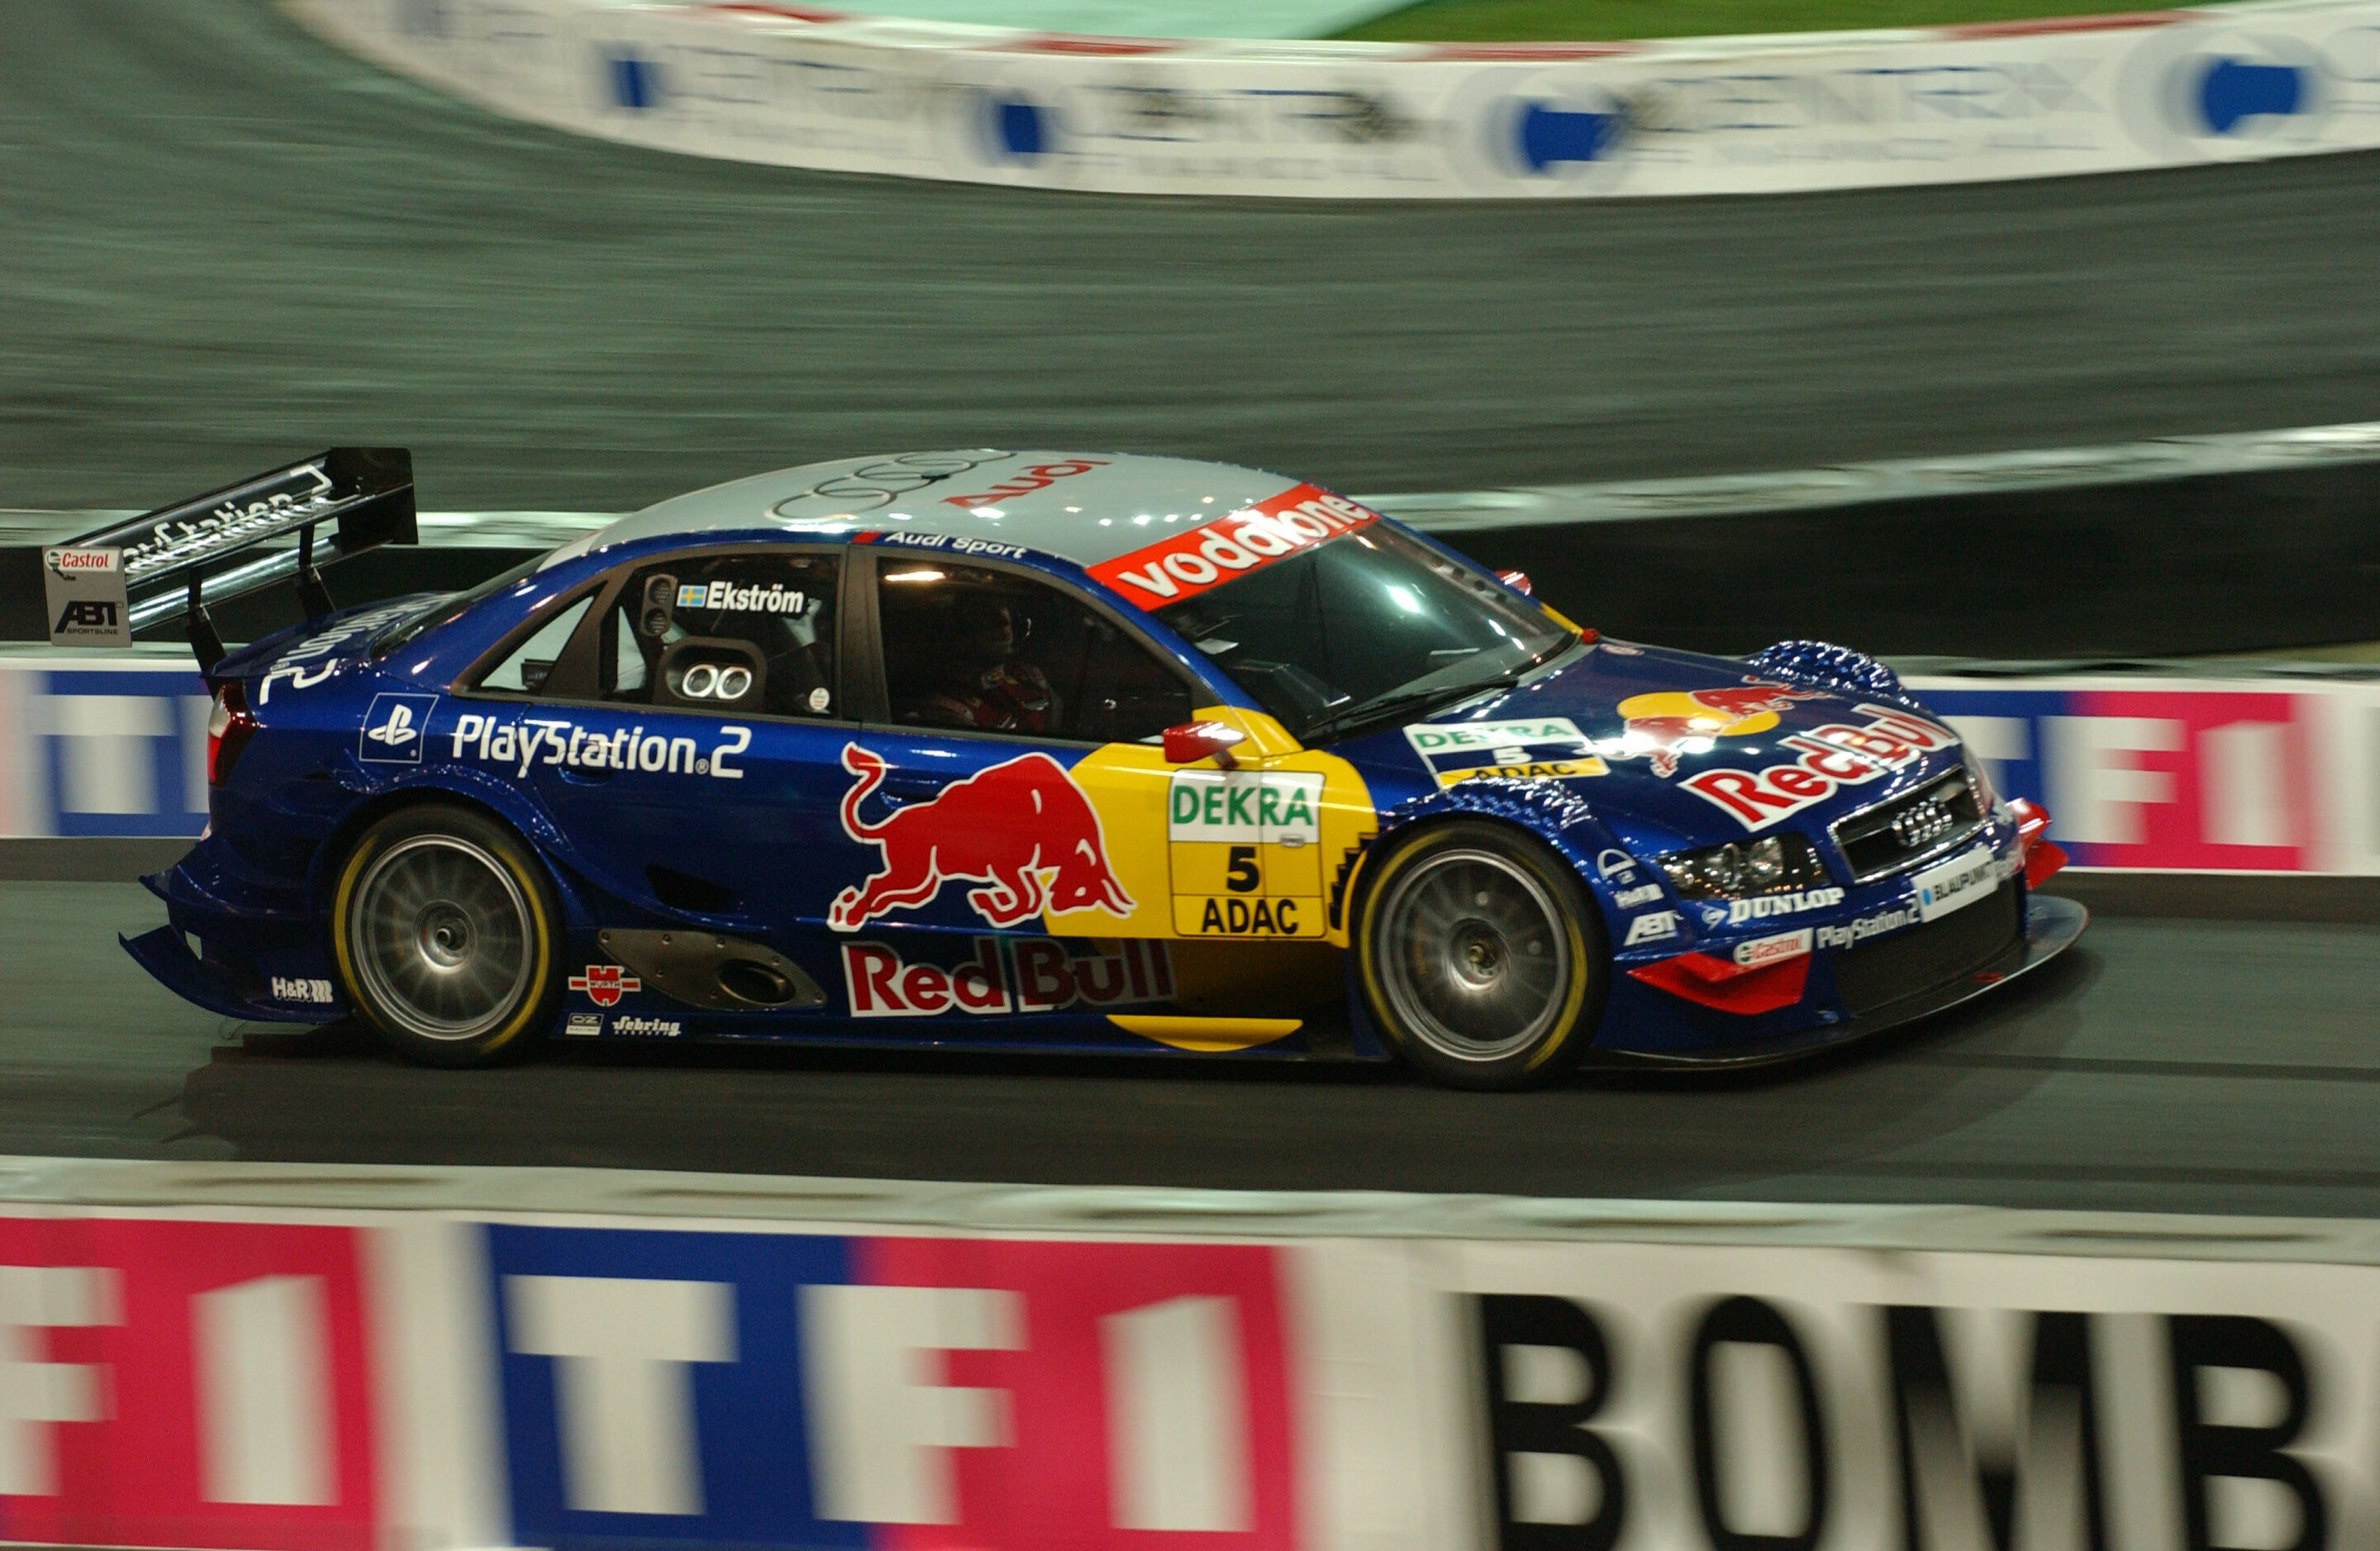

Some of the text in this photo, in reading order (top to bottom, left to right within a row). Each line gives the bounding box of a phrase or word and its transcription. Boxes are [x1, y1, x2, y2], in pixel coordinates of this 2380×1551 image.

[939, 458, 1114, 510] Audi
[62, 552, 110, 569] Castrol
[885, 530, 1028, 559] Audi Sport
[706, 580, 805, 613] Ekström
[54, 601, 117, 635] ABT
[1414, 723, 1574, 748] DERA
[1474, 763, 1577, 781] ADAC
[1492, 745, 1533, 766] 5
[1676, 735, 1889, 833] Red
[1173, 786, 1314, 826] DEKRA
[1227, 846, 1260, 892] 5
[1201, 897, 1299, 935] ADAC
[1726, 887, 1845, 925] DUNLOP
[1816, 898, 1920, 949] PlayStation 2
[271, 976, 311, 1001] H&R
[841, 937, 1177, 1018] Red Bull
[612, 1016, 681, 1037] Sebring
[500, 1273, 1258, 1534] TF1
[1442, 1291, 2332, 1551] BOMB
